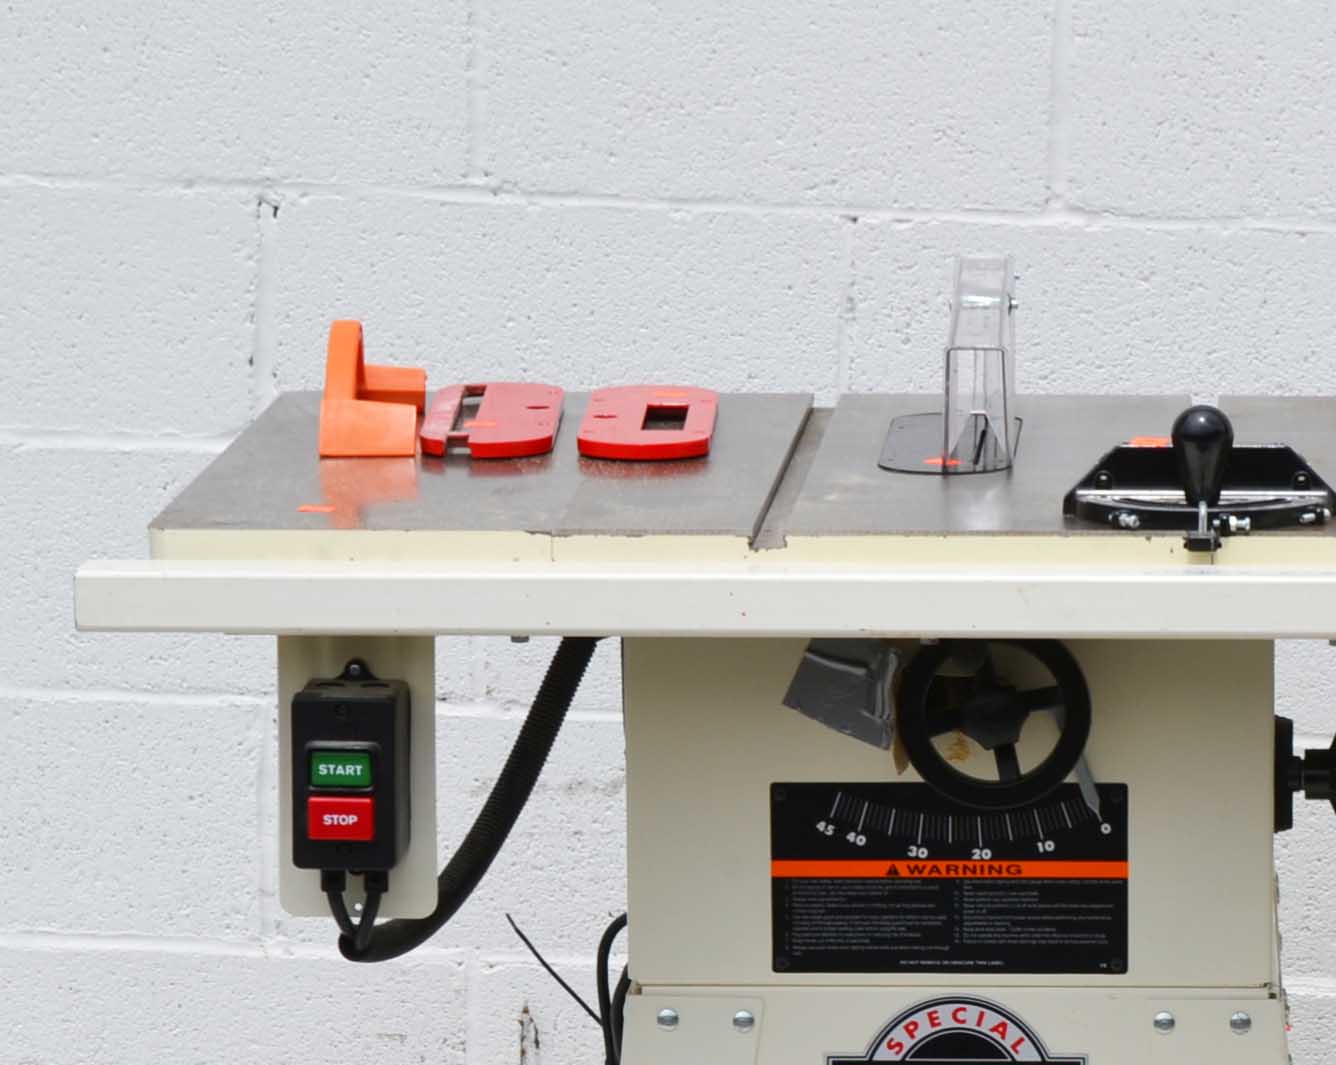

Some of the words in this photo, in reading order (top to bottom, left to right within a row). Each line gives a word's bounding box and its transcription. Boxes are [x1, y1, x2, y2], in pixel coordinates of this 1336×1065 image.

[319, 764, 363, 776] START
[323, 814, 358, 826] STOP
[816, 819, 835, 837] 45
[845, 831, 866, 847] 40
[907, 845, 929, 859] 30
[971, 848, 992, 860] 20
[1037, 840, 1055, 853] 10
[1100, 823, 1112, 835] 0
[907, 864, 1022, 875] WARNING
[886, 1007, 1025, 1055] SPECIAL
